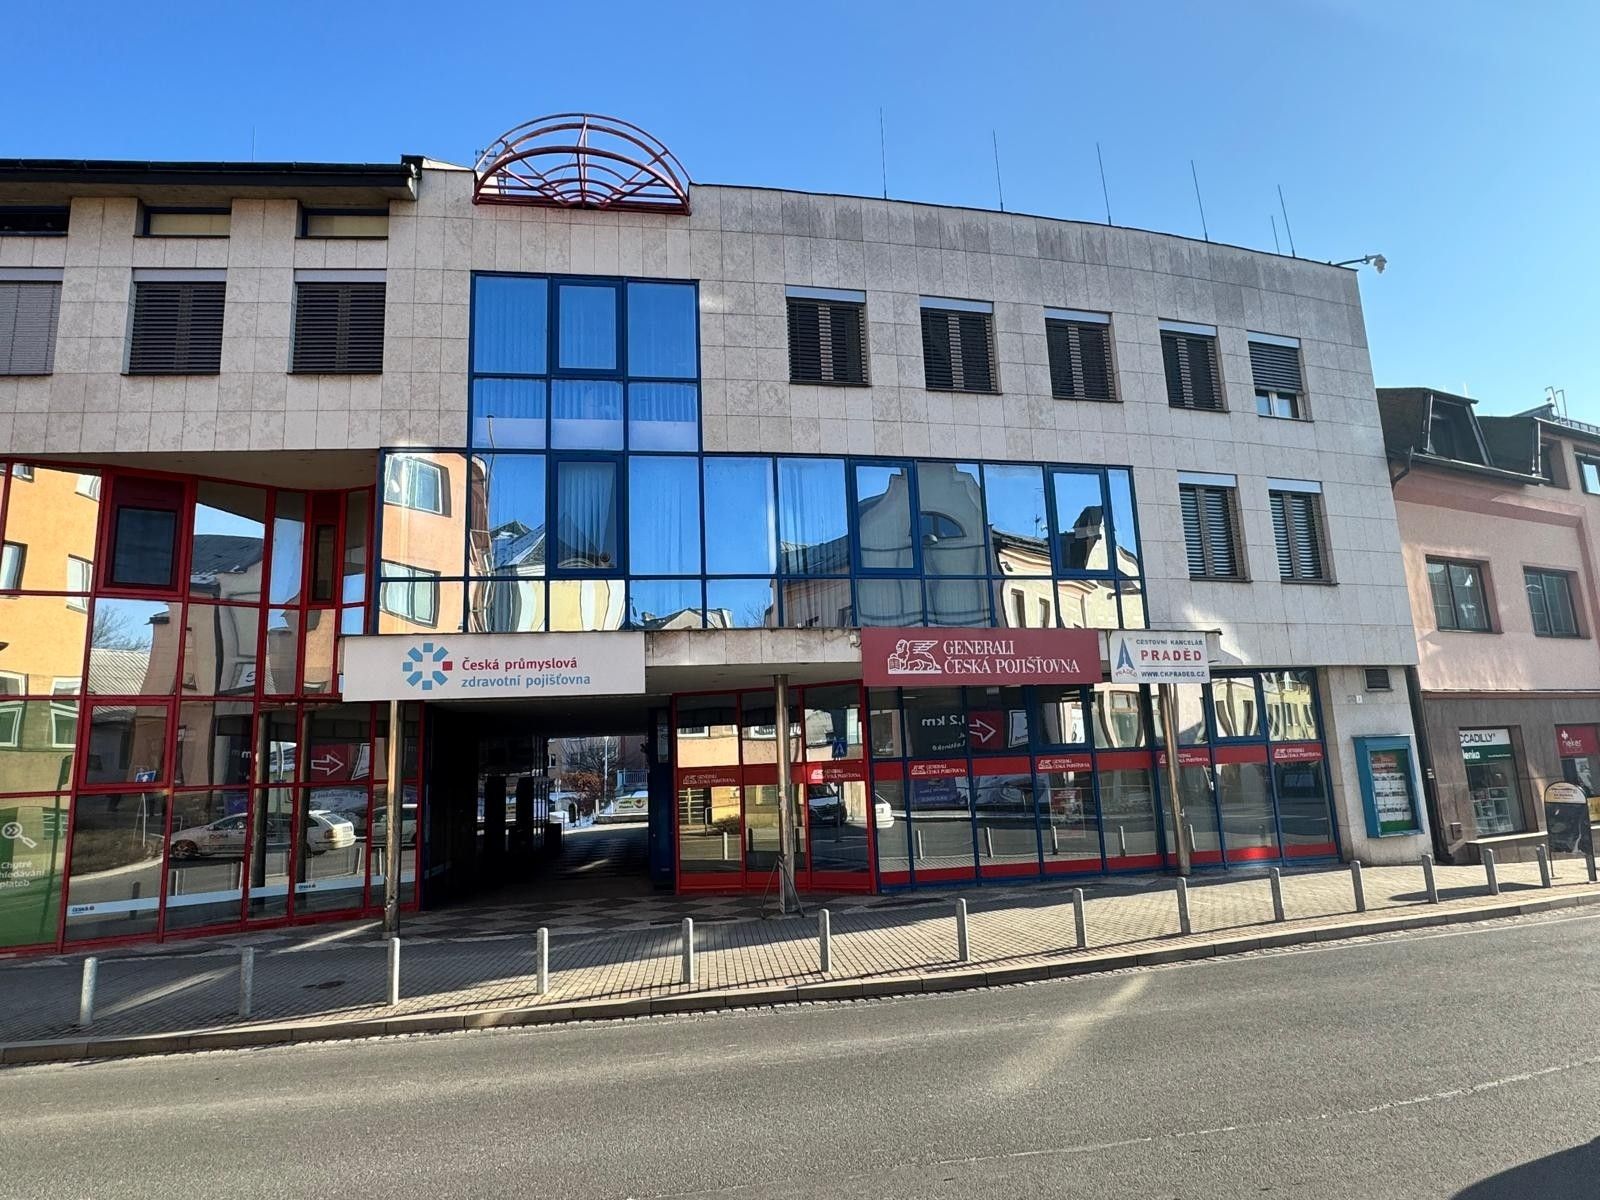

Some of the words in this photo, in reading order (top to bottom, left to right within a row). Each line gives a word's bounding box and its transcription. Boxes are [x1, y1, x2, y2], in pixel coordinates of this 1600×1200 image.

[943, 639, 1015, 655] GENERALI
[1140, 648, 1201, 661] PRADĚD
[461, 656, 499, 671] Česká
[504, 656, 578, 672] průmyslová
[944, 656, 991, 674] ČESKÁ
[995, 656, 1080, 674] POJIŠŤOVNA
[461, 674, 521, 688] zdravotní
[525, 673, 591, 689] pojišťovna
